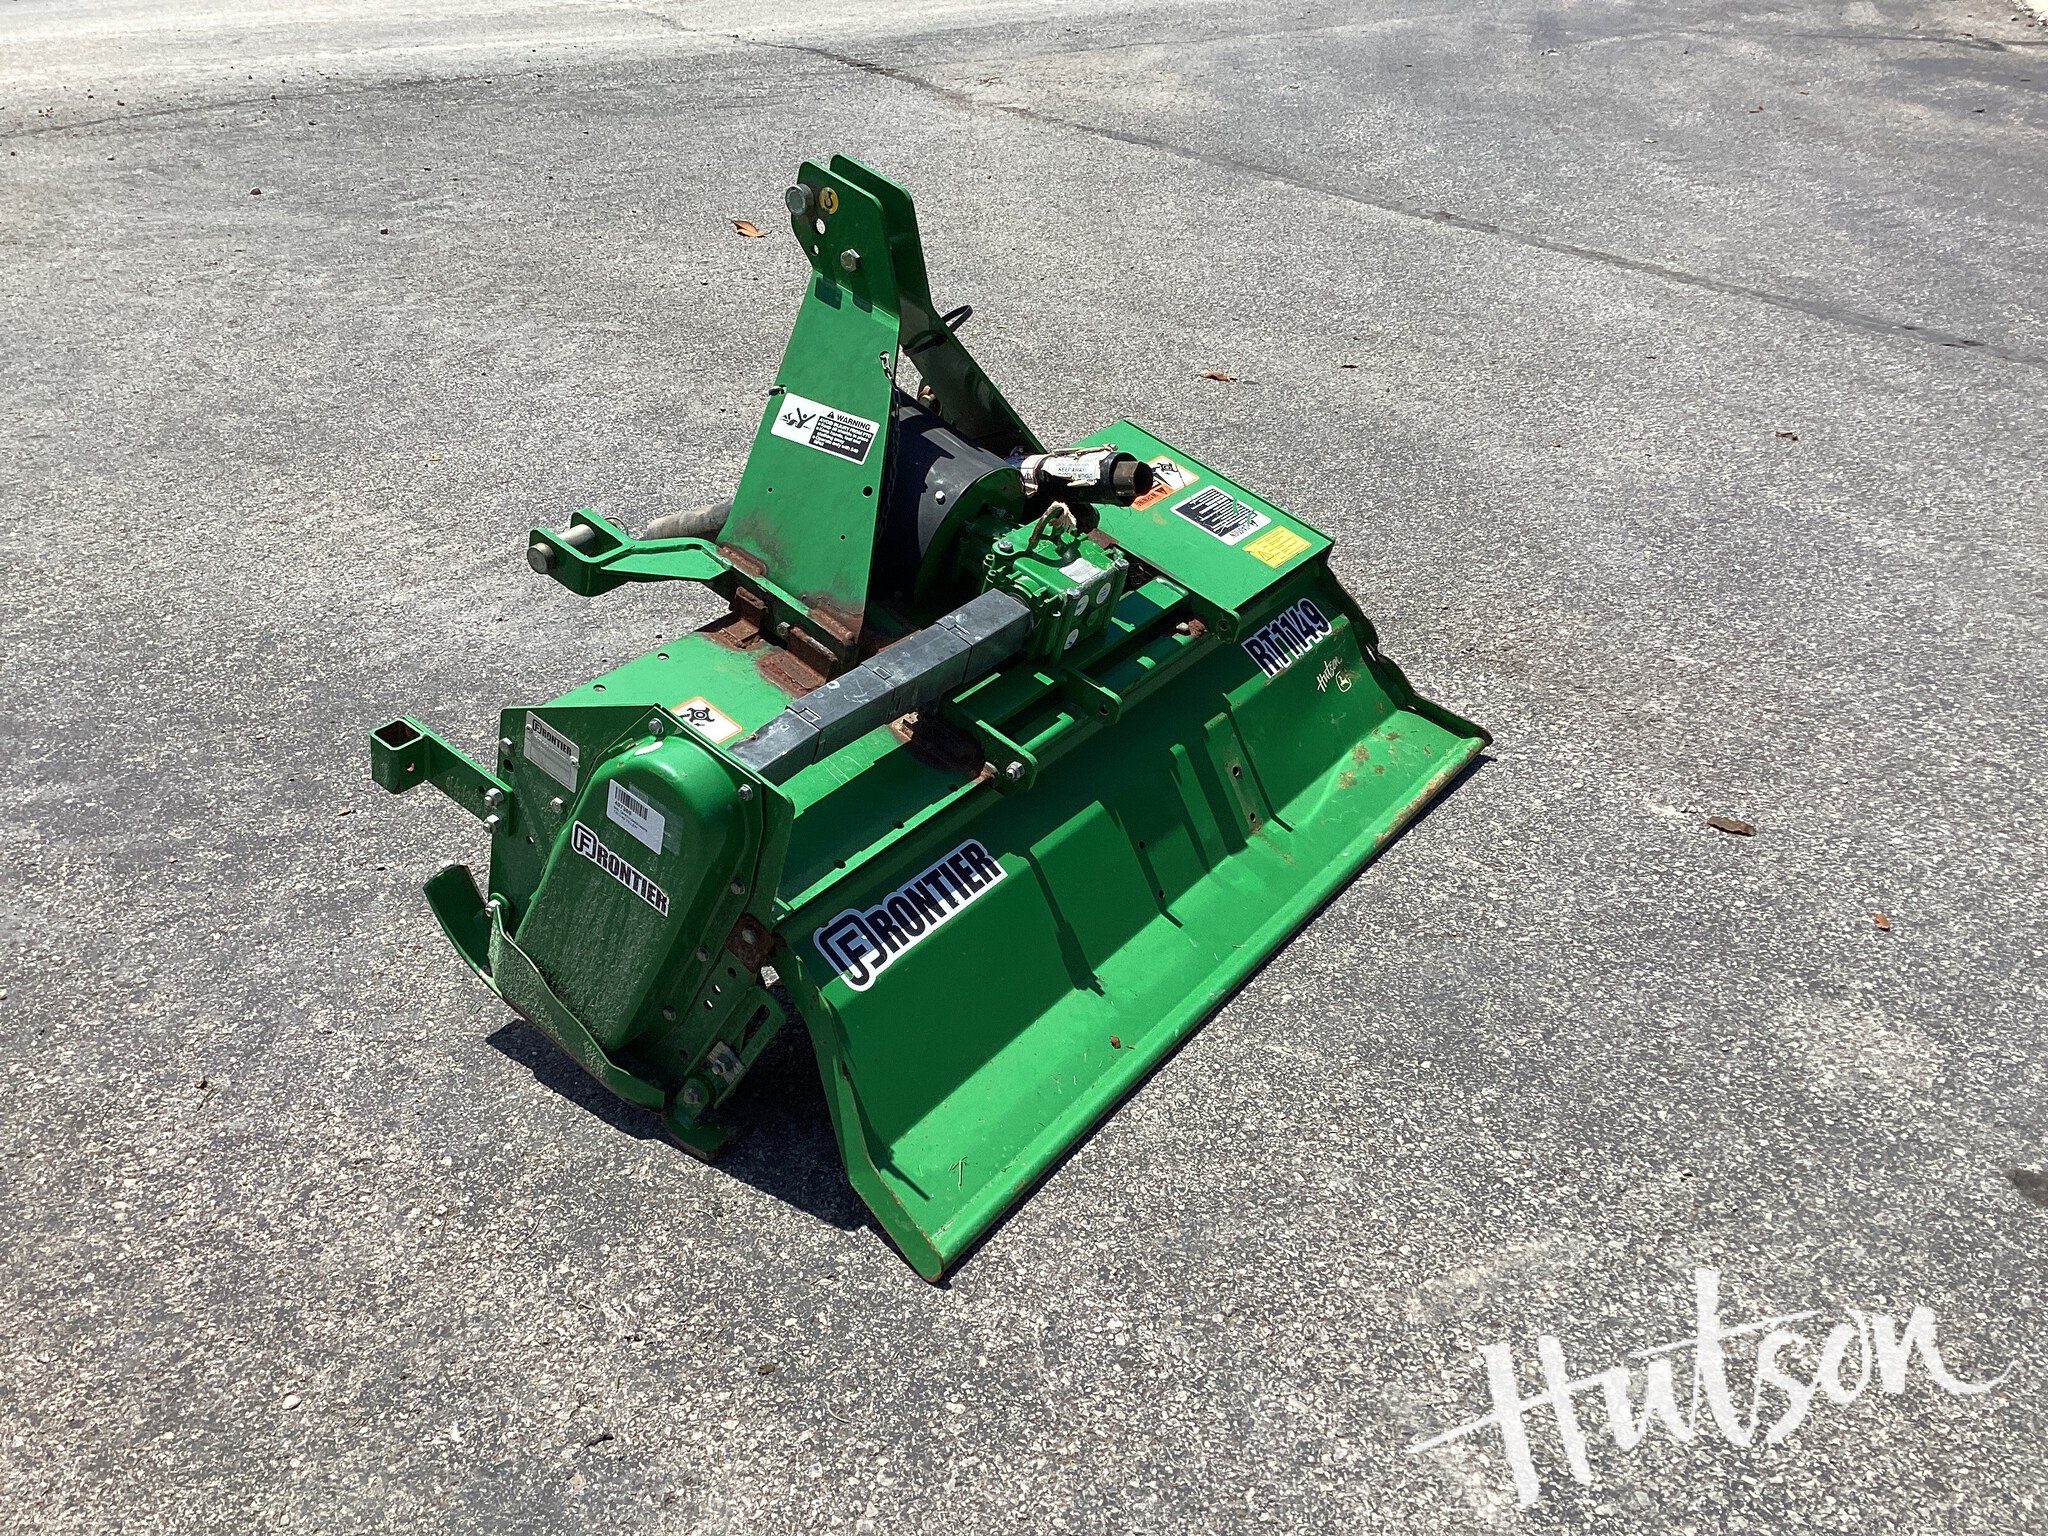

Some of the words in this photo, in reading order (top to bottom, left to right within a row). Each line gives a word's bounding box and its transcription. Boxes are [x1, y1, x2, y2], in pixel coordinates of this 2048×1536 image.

[836, 414, 870, 430] WARNING
[1242, 600, 1331, 677] RT1149
[1316, 656, 1342, 692] Hutson
[532, 718, 572, 756] FRONTIER
[573, 823, 668, 914] FRONTIER
[817, 842, 1003, 987] FRONTIER
